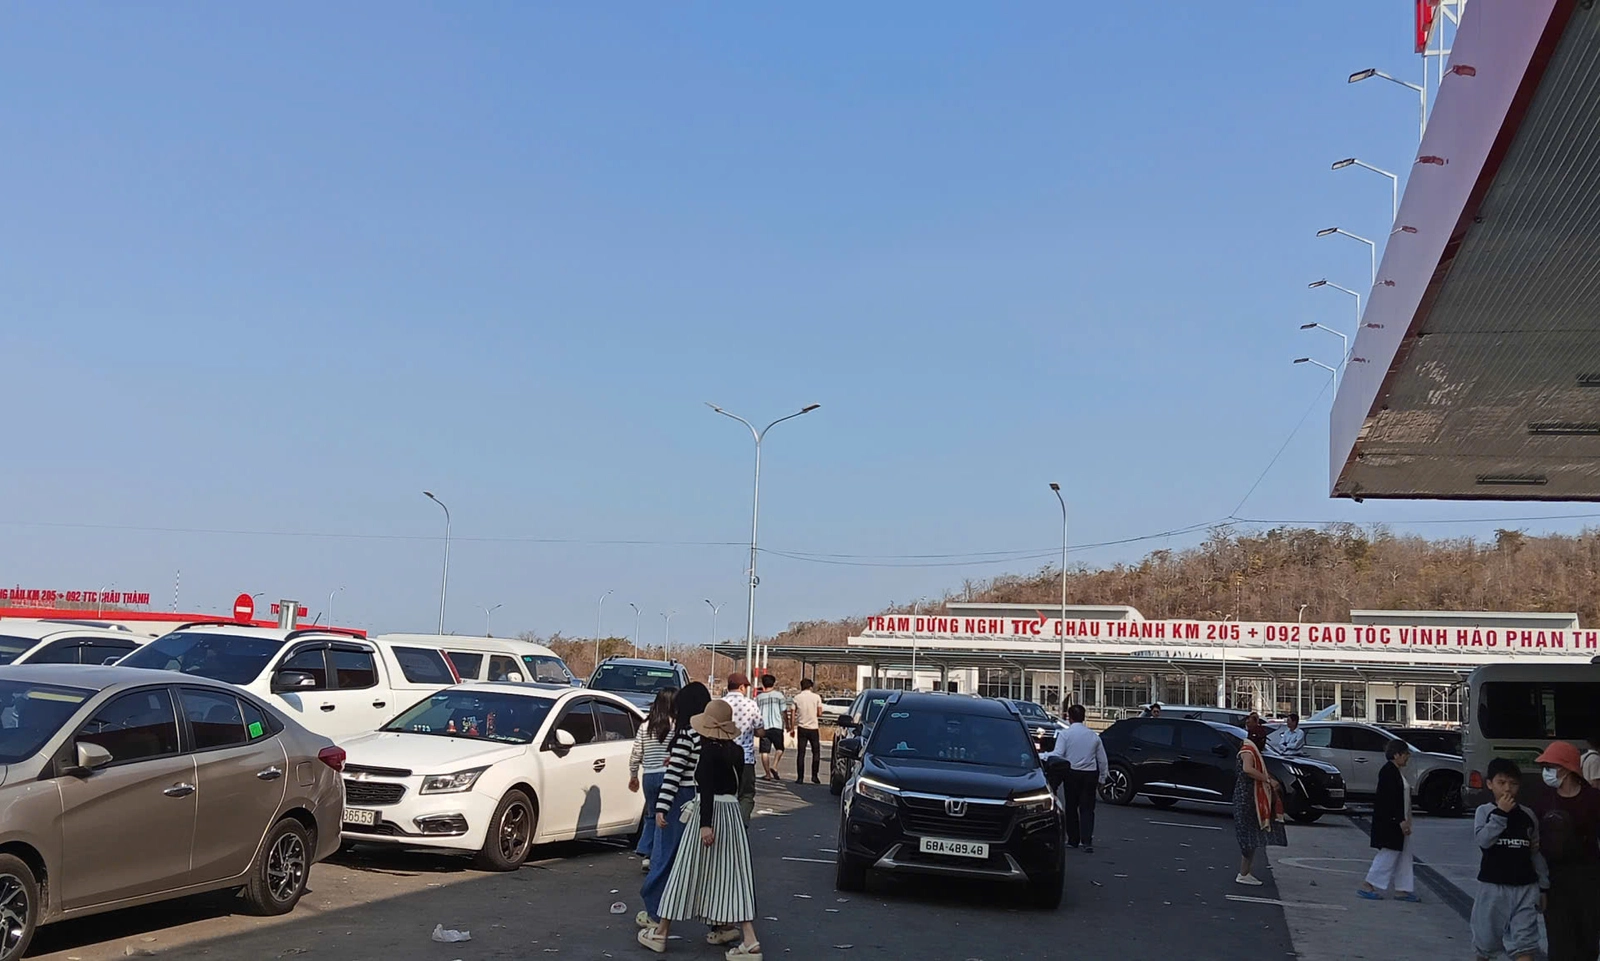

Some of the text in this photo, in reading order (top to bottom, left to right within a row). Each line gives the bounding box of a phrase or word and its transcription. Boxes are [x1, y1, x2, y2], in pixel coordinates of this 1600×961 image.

[27, 590, 40, 601] KM
[41, 590, 57, 602] 205
[66, 590, 81, 602] 092
[83, 591, 97, 603] TTC
[99, 590, 121, 604] CHÂU
[123, 590, 150, 604] THÀNH
[867, 616, 910, 635] TRẠM
[916, 615, 959, 633] DỪNG
[1011, 619, 1041, 635] TTC
[1054, 618, 1100, 637] CHÂU
[1107, 619, 1165, 639] THÀNH
[1173, 623, 1199, 639] KM
[1207, 624, 1240, 641] 205
[1247, 627, 1259, 638] +
[1266, 625, 1300, 642] 092
[1308, 626, 1346, 643] CAO
[1354, 622, 1391, 645] TỐC
[1399, 625, 1447, 646] VĨNH
[1457, 624, 1497, 647] HẢO
[1506, 630, 1564, 649] PHAN
[925, 840, 984, 856] 68A-489.48
